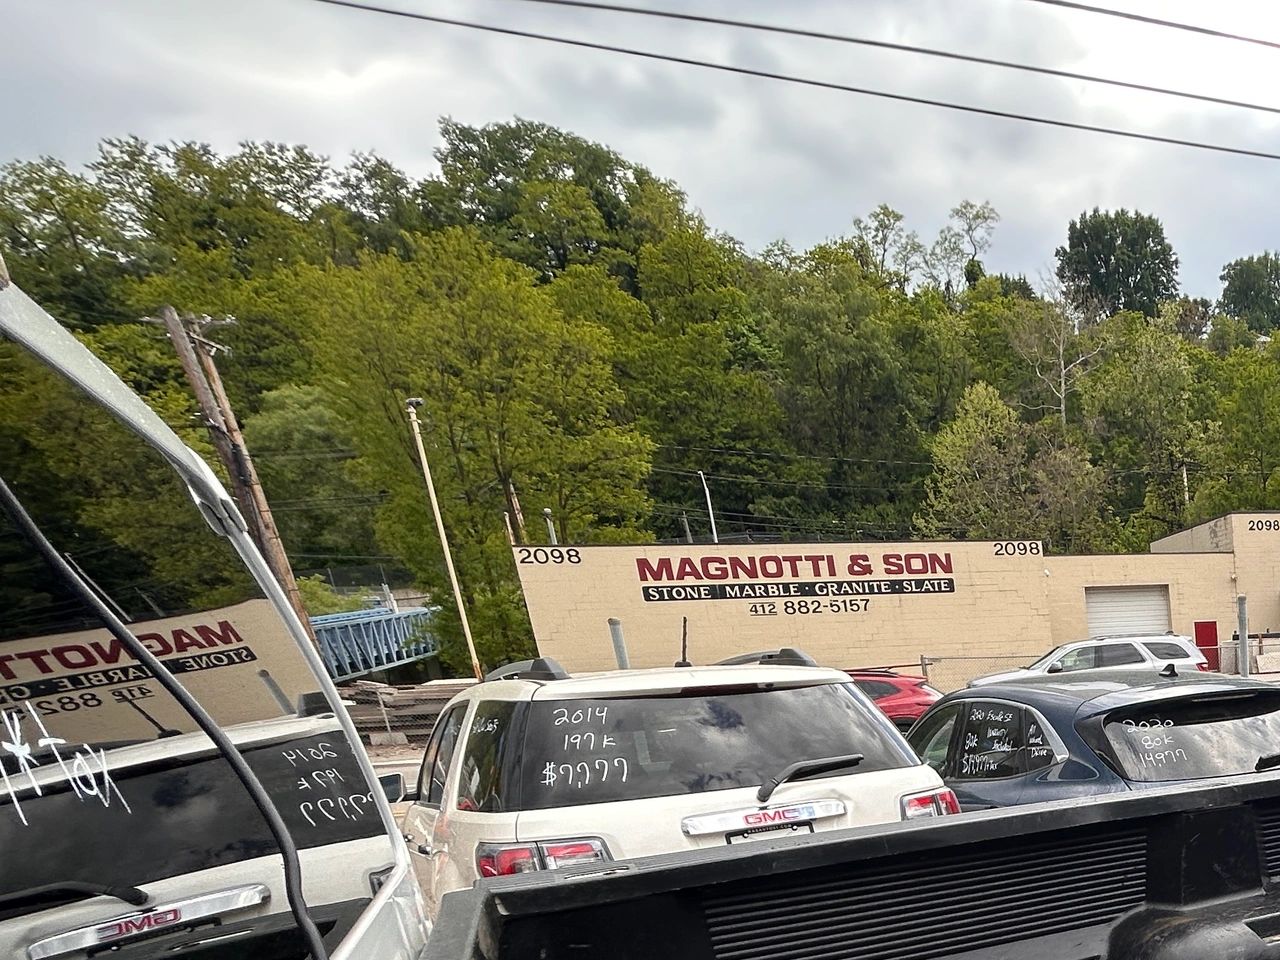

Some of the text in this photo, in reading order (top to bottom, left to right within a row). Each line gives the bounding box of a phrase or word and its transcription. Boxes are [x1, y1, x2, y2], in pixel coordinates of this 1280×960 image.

[1247, 518, 1280, 532] 2098
[518, 548, 582, 565] 2098
[993, 541, 1041, 557] 2098
[635, 552, 953, 582] MAGNOTTI & SON
[648, 578, 951, 600] STONE MARBLE GRANITE SLATE
[749, 598, 870, 615] 412 882-5157
[553, 707, 608, 726] 2014
[743, 808, 801, 825] GMC
